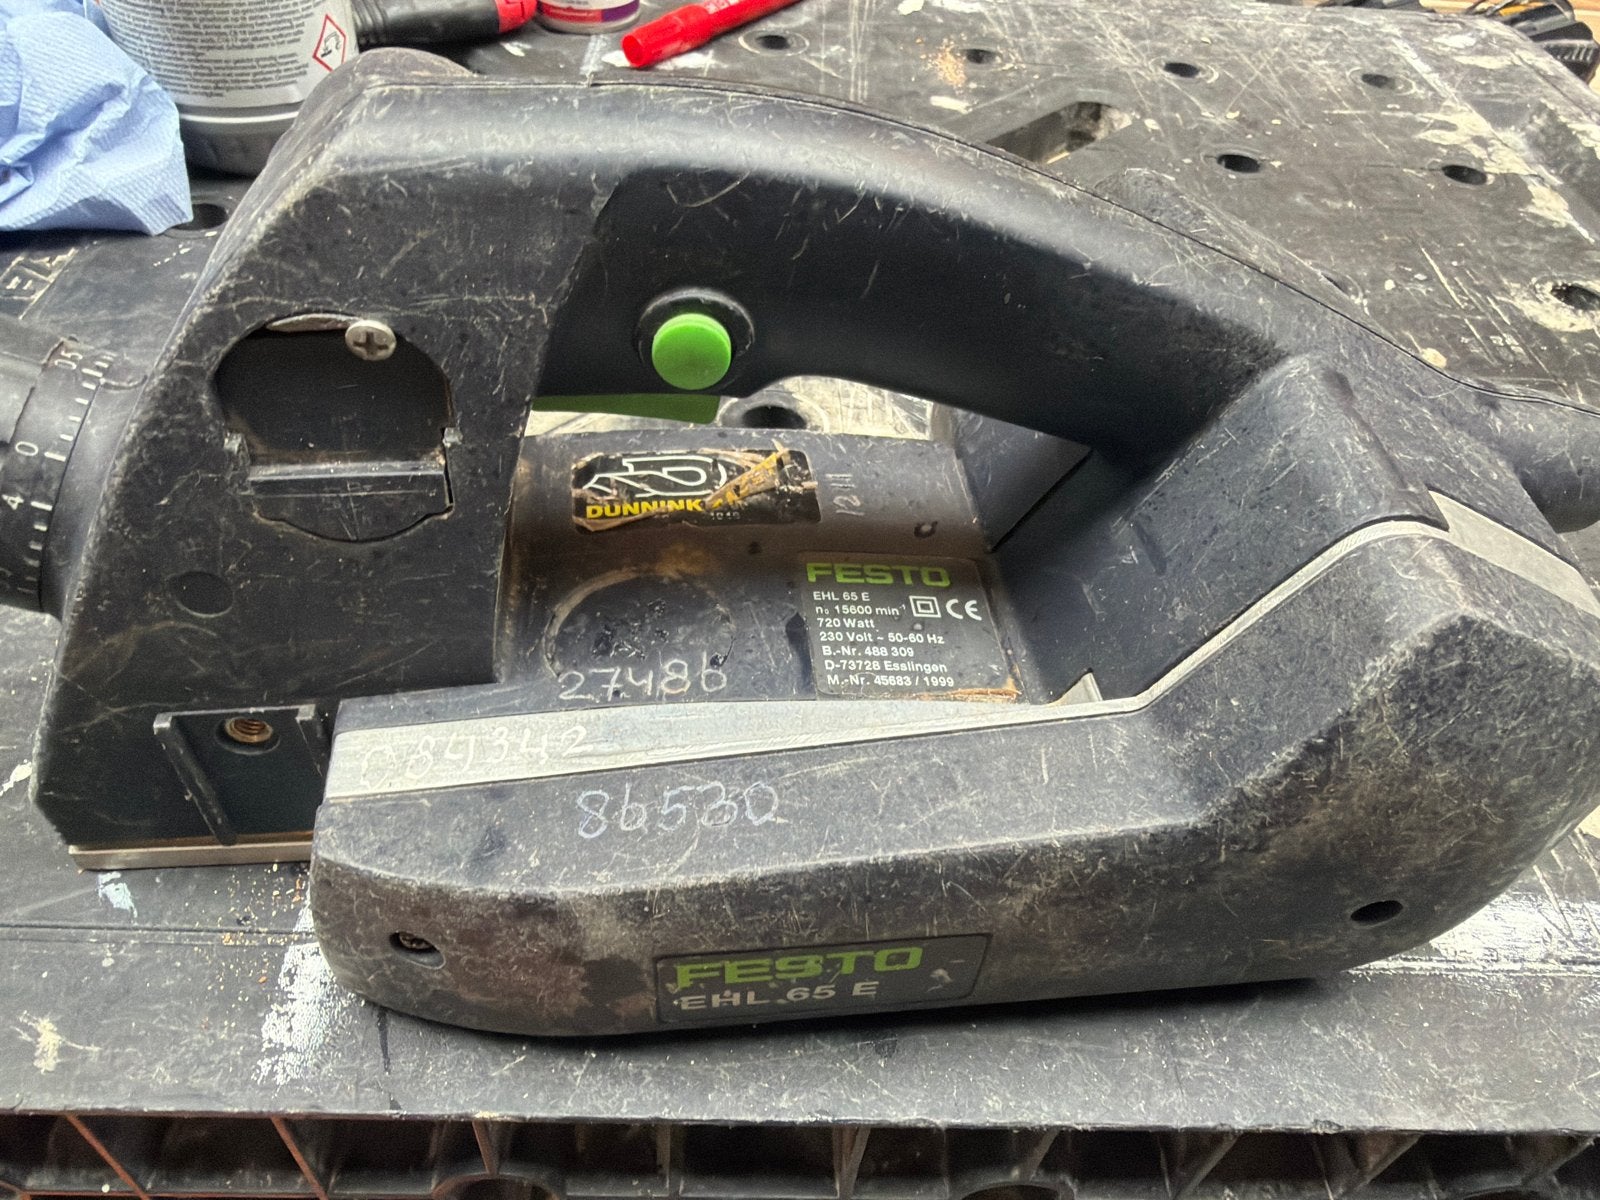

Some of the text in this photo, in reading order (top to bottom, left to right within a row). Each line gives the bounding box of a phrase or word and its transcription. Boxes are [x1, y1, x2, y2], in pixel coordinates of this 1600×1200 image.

[1, 494, 24, 510] 4
[586, 498, 705, 519] DUNNINK
[806, 562, 950, 588] FESTO
[813, 591, 870, 602] EHL 65 E
[834, 604, 873, 615] 15600
[816, 618, 875, 629] 720 Watt
[819, 631, 844, 643] 230
[846, 632, 873, 643] Volt
[888, 632, 924, 644] 50-60
[927, 633, 945, 645] Hz
[822, 646, 914, 658] B.-Nr. 488 309
[825, 659, 948, 674] D-73728 Esslingen
[827, 674, 870, 686] M.-Nr.
[923, 676, 955, 688] 1999
[674, 946, 924, 989] FESTO
[680, 981, 880, 1012] EHL 65 E
